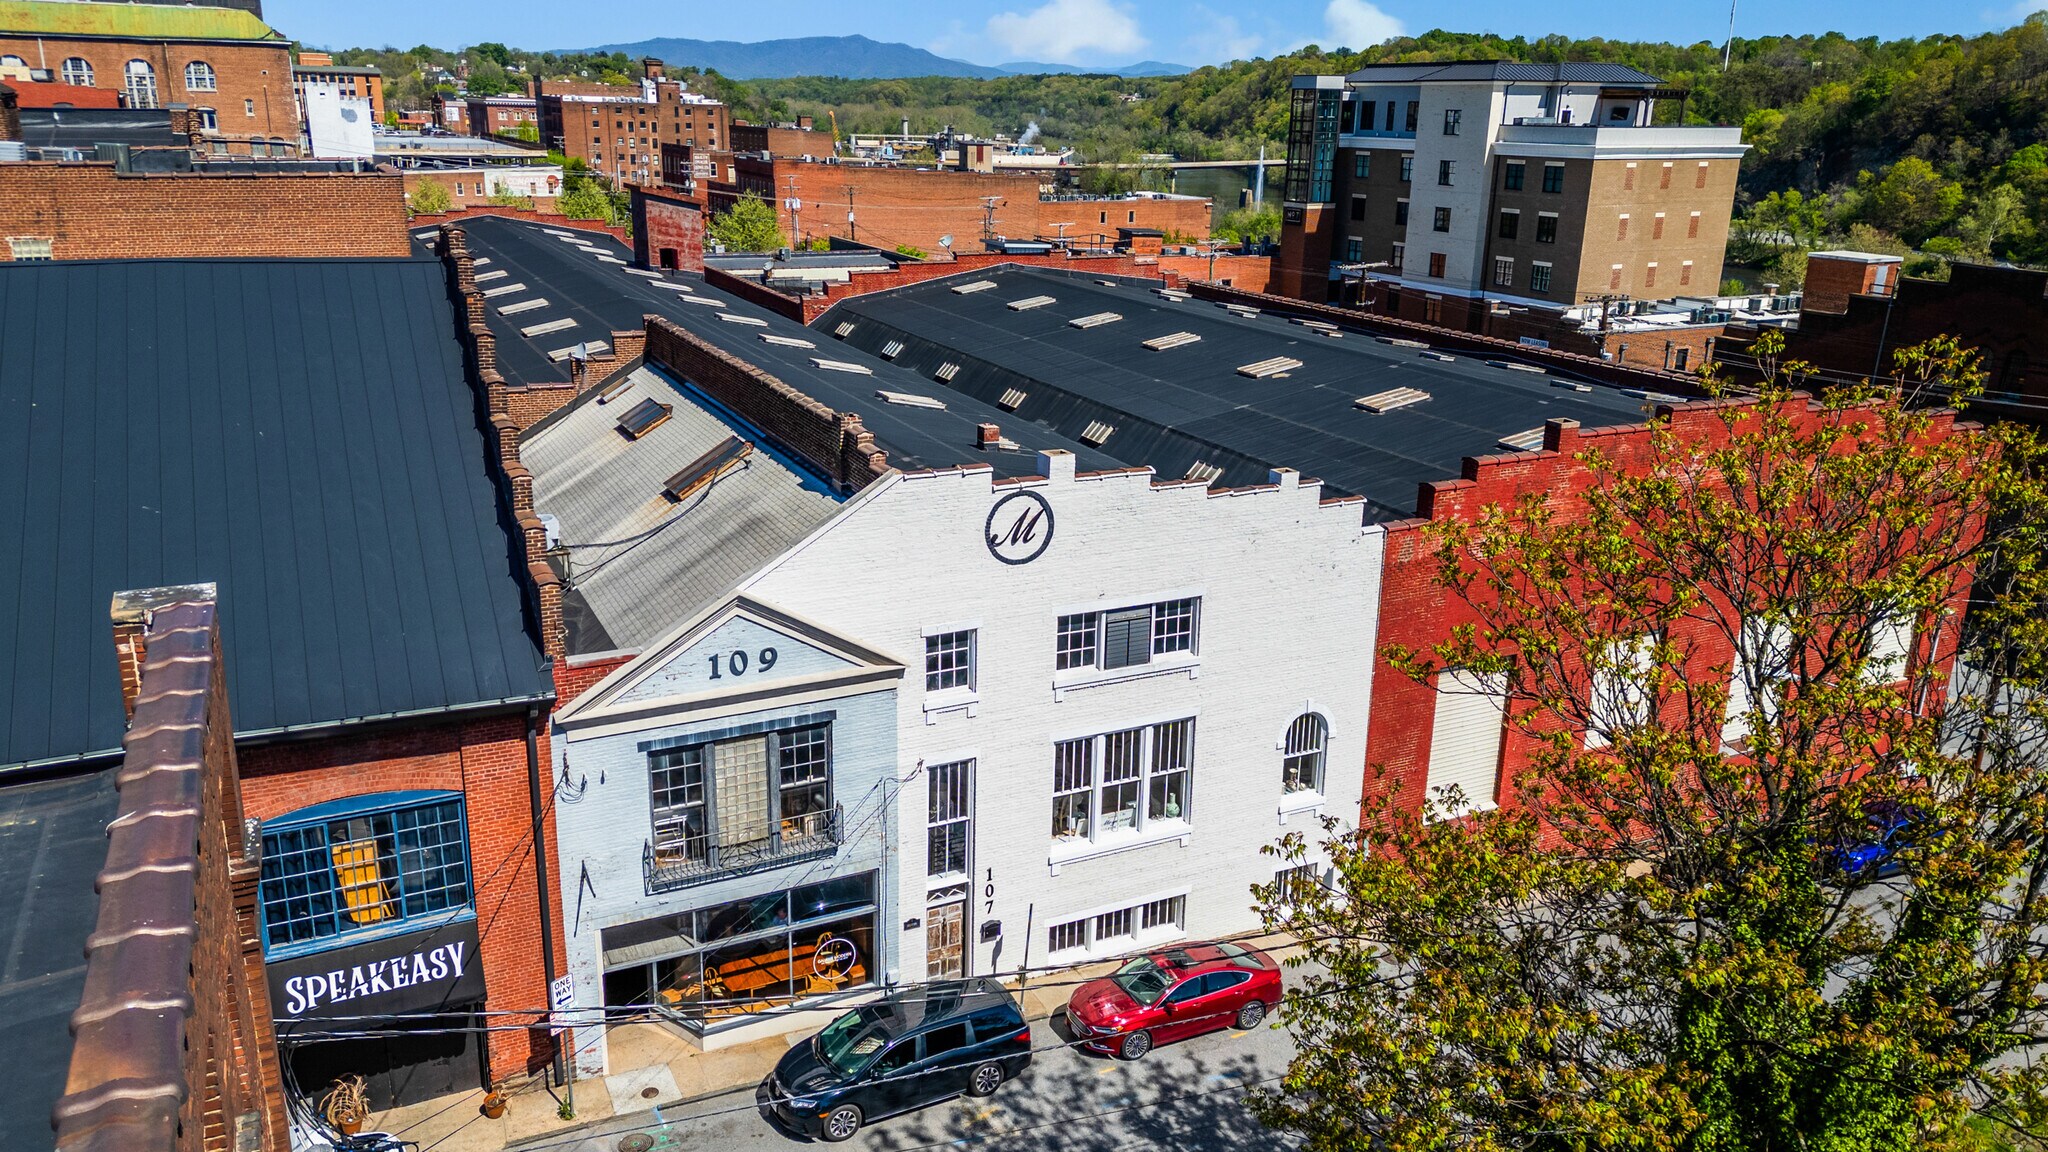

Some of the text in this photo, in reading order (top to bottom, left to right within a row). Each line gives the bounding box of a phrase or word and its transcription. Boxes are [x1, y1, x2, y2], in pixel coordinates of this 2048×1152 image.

[990, 506, 1046, 548] M
[708, 646, 778, 680] 109
[984, 867, 995, 915] 107
[285, 941, 465, 1014] SPEAKEASY
[554, 976, 571, 990] ONE
[555, 984, 572, 998] WAY
